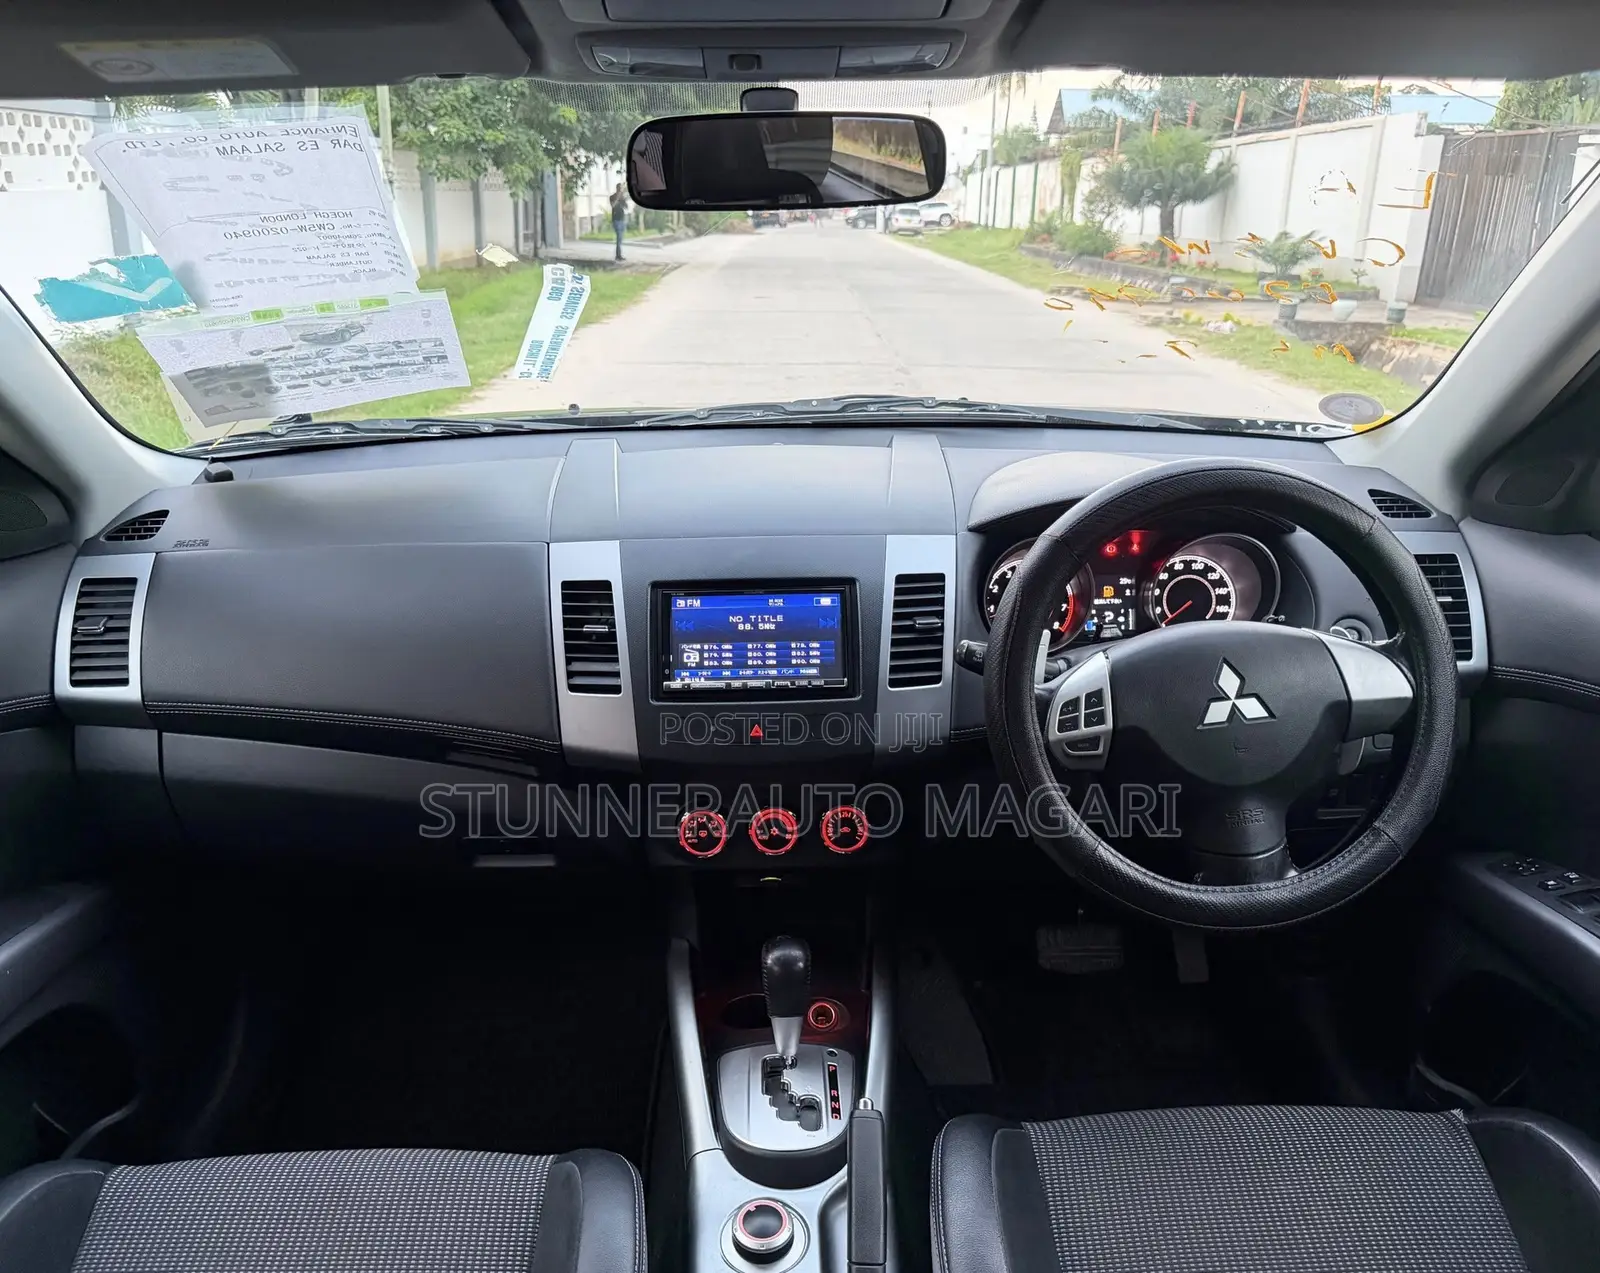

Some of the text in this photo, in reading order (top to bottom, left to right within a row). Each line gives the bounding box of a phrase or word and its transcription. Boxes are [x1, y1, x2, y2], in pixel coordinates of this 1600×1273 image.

[1173, 562, 1184, 570] 80
[1191, 562, 1205, 570] 100
[1005, 571, 1013, 579] 3
[1158, 572, 1169, 580] 60
[1207, 572, 1220, 580] 120
[992, 584, 999, 593] 2
[1214, 587, 1229, 595] 140
[686, 599, 701, 608] FM
[1061, 603, 1068, 612] 7
[1215, 605, 1230, 613] 160
[729, 614, 784, 623] NO TITLE
[1053, 621, 1060, 630] 8
[831, 1089, 838, 1097] R
